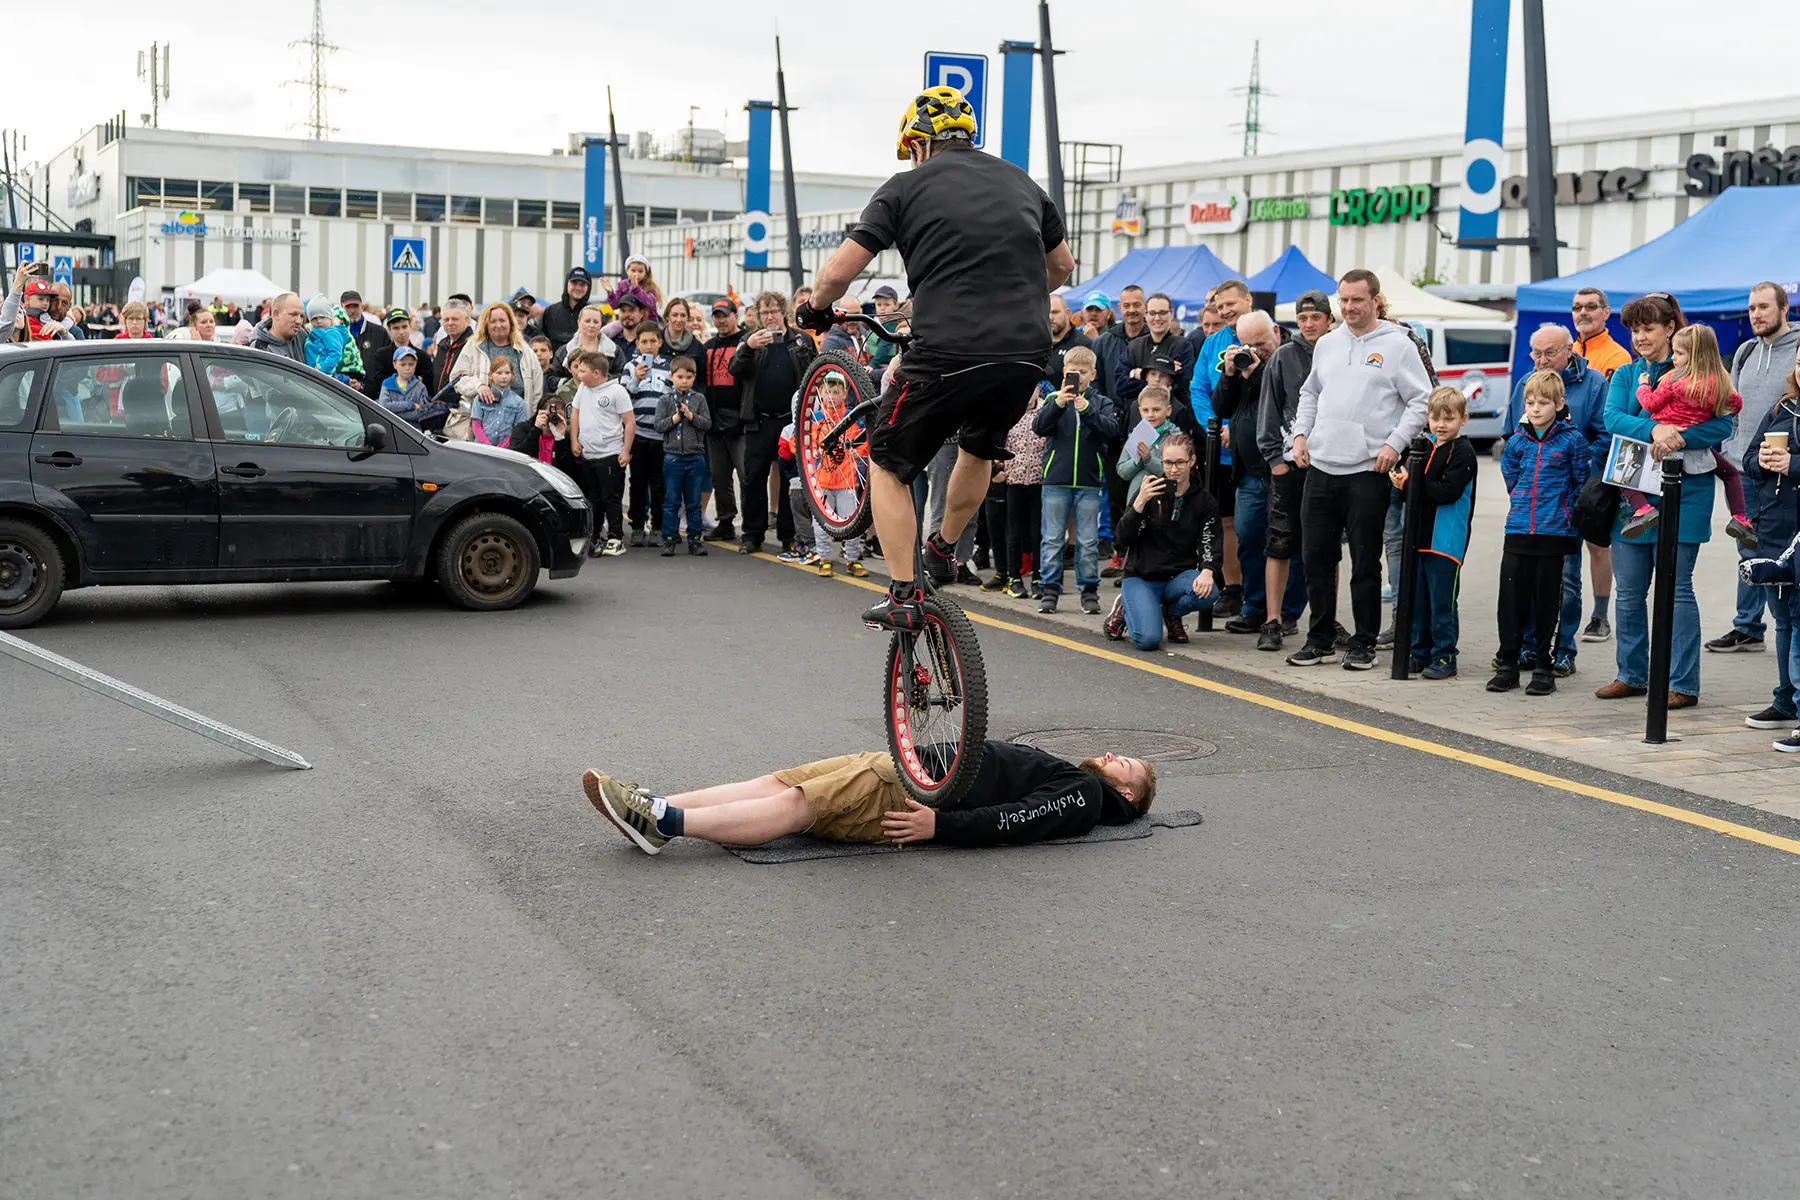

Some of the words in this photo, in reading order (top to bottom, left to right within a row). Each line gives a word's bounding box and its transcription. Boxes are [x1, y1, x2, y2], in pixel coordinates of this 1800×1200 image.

[939, 64, 973, 97] P
[1115, 192, 1138, 220] dm
[1328, 183, 1434, 227] CROPP
[160, 220, 208, 237] albert
[215, 225, 303, 241] HYPERMARKET
[20, 245, 32, 260] P
[997, 789, 1087, 831] Pushyourself
